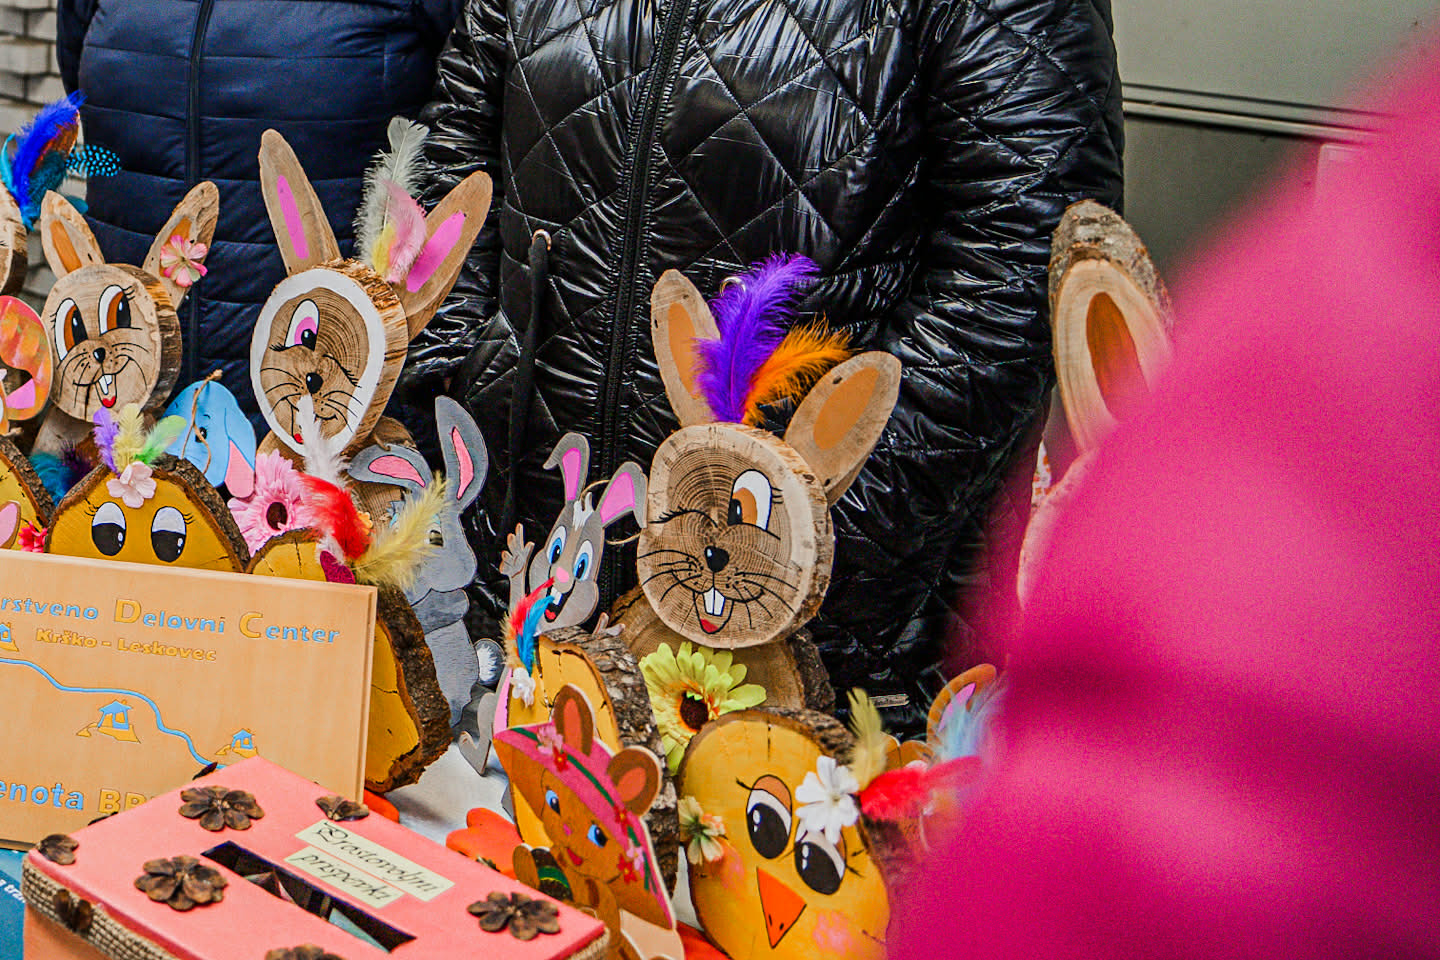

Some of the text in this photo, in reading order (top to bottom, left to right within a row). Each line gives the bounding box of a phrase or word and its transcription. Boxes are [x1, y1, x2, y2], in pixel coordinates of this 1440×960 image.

[113, 598, 227, 635] Delovni
[238, 611, 342, 645] Center
[35, 627, 98, 650] Krško
[117, 637, 218, 663] Leskovec
